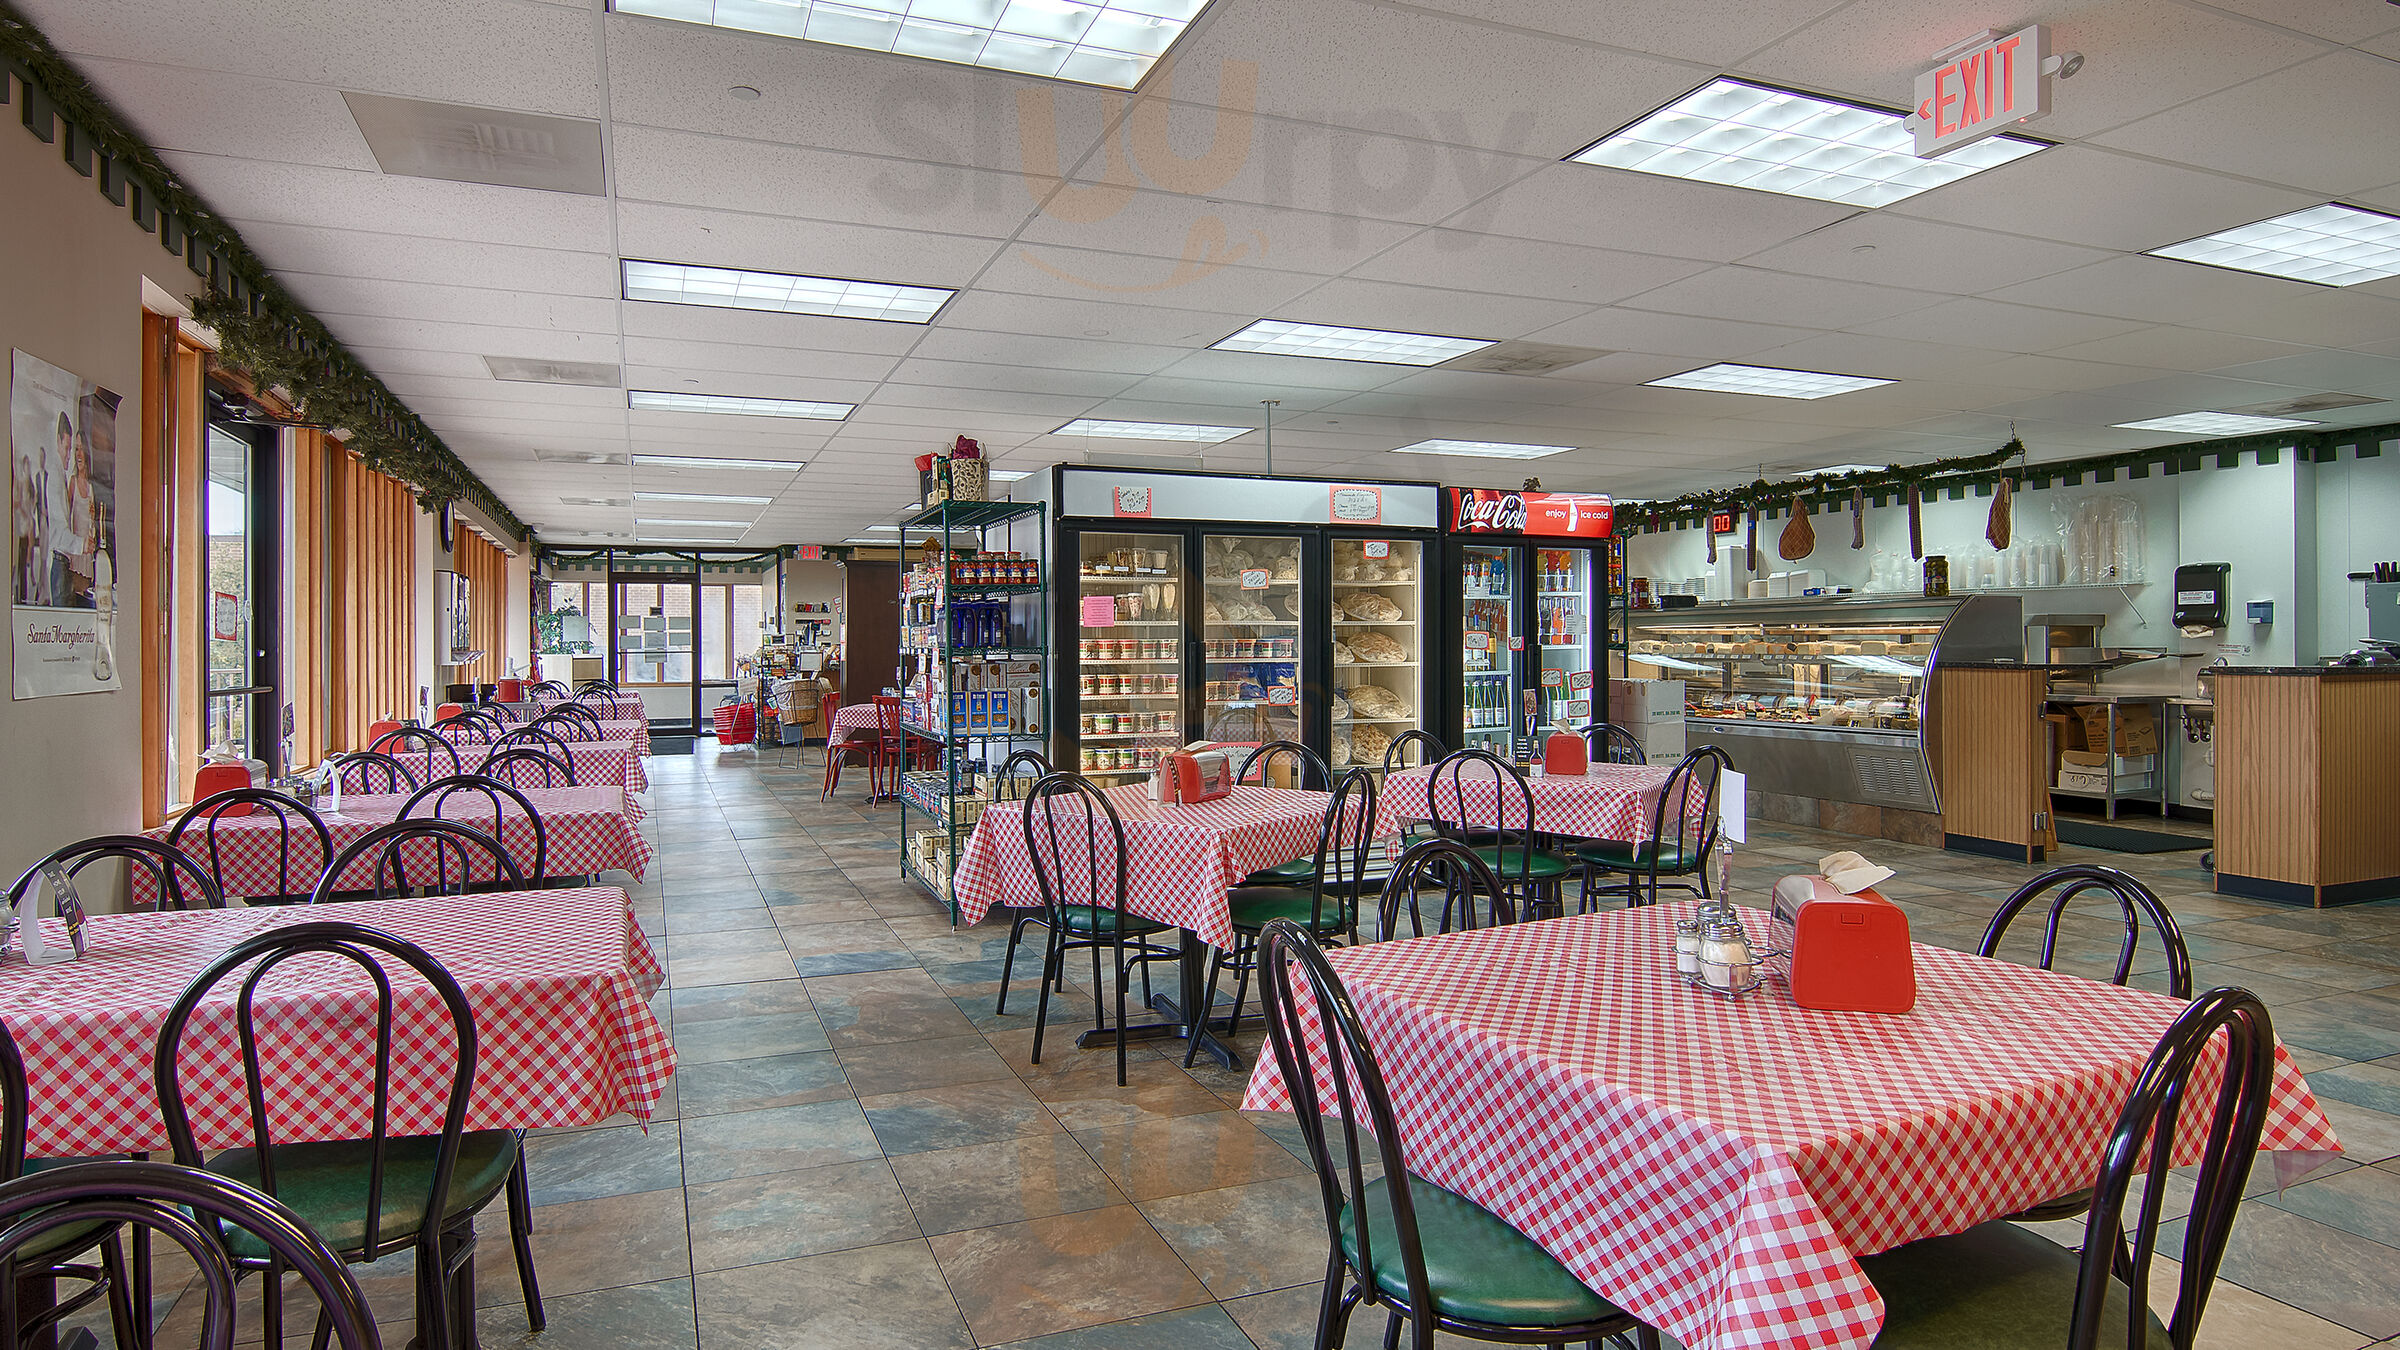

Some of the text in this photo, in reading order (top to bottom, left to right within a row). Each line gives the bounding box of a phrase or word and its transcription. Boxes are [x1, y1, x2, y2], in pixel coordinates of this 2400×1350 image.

[1935, 36, 2021, 139] EXIT
[1457, 493, 1527, 530] Coca-Cola
[1545, 509, 1567, 519] enjoy
[1592, 510, 1609, 520] cold
[802, 545, 820, 559] EXIT
[27, 623, 96, 650] Santa Margherita
